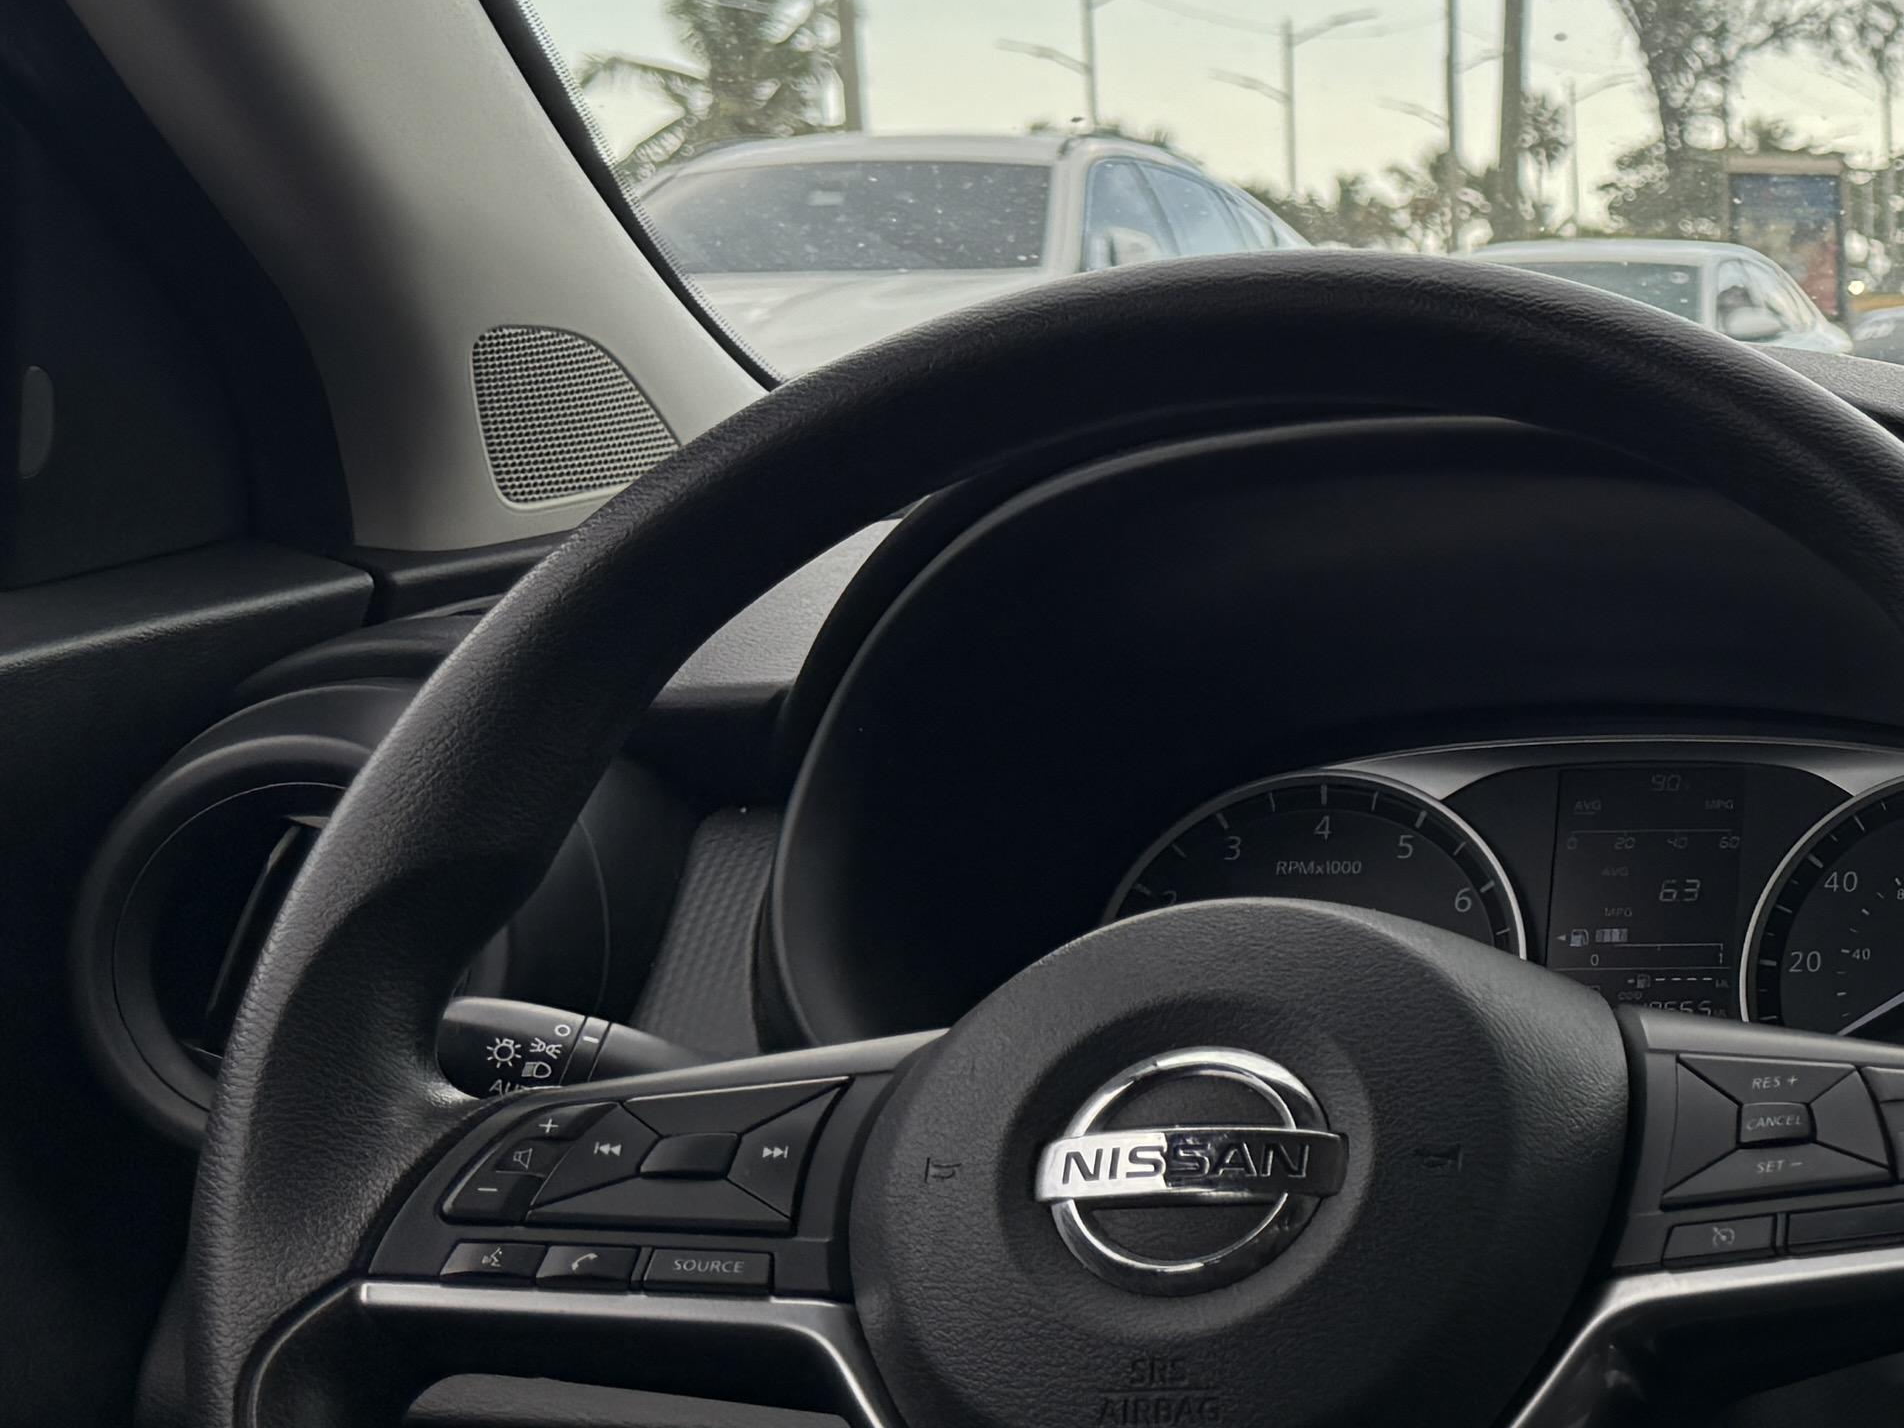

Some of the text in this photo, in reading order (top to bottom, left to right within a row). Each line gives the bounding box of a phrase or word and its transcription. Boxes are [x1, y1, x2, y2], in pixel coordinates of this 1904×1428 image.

[1313, 815, 1332, 840] 4
[1223, 835, 1241, 861] 3
[1396, 834, 1414, 860] 5
[1614, 837, 1636, 850] 20
[1667, 837, 1688, 850] 40
[1718, 836, 1740, 849] 60
[1275, 860, 1362, 876] RPMx1000
[1824, 871, 1858, 892] 40
[1454, 887, 1472, 913] 6
[1590, 954, 1600, 966] 0
[1789, 951, 1821, 972] 20
[1851, 948, 1871, 960] 40
[1752, 1077, 1781, 1089] RES
[1746, 1115, 1803, 1130] CANCEL
[1061, 1141, 1312, 1185] NISSAN
[1756, 1160, 1783, 1173] SET
[672, 1257, 745, 1274] SOURCE
[1129, 1356, 1189, 1387] SRS
[1097, 1395, 1222, 1428] AIRBAG
